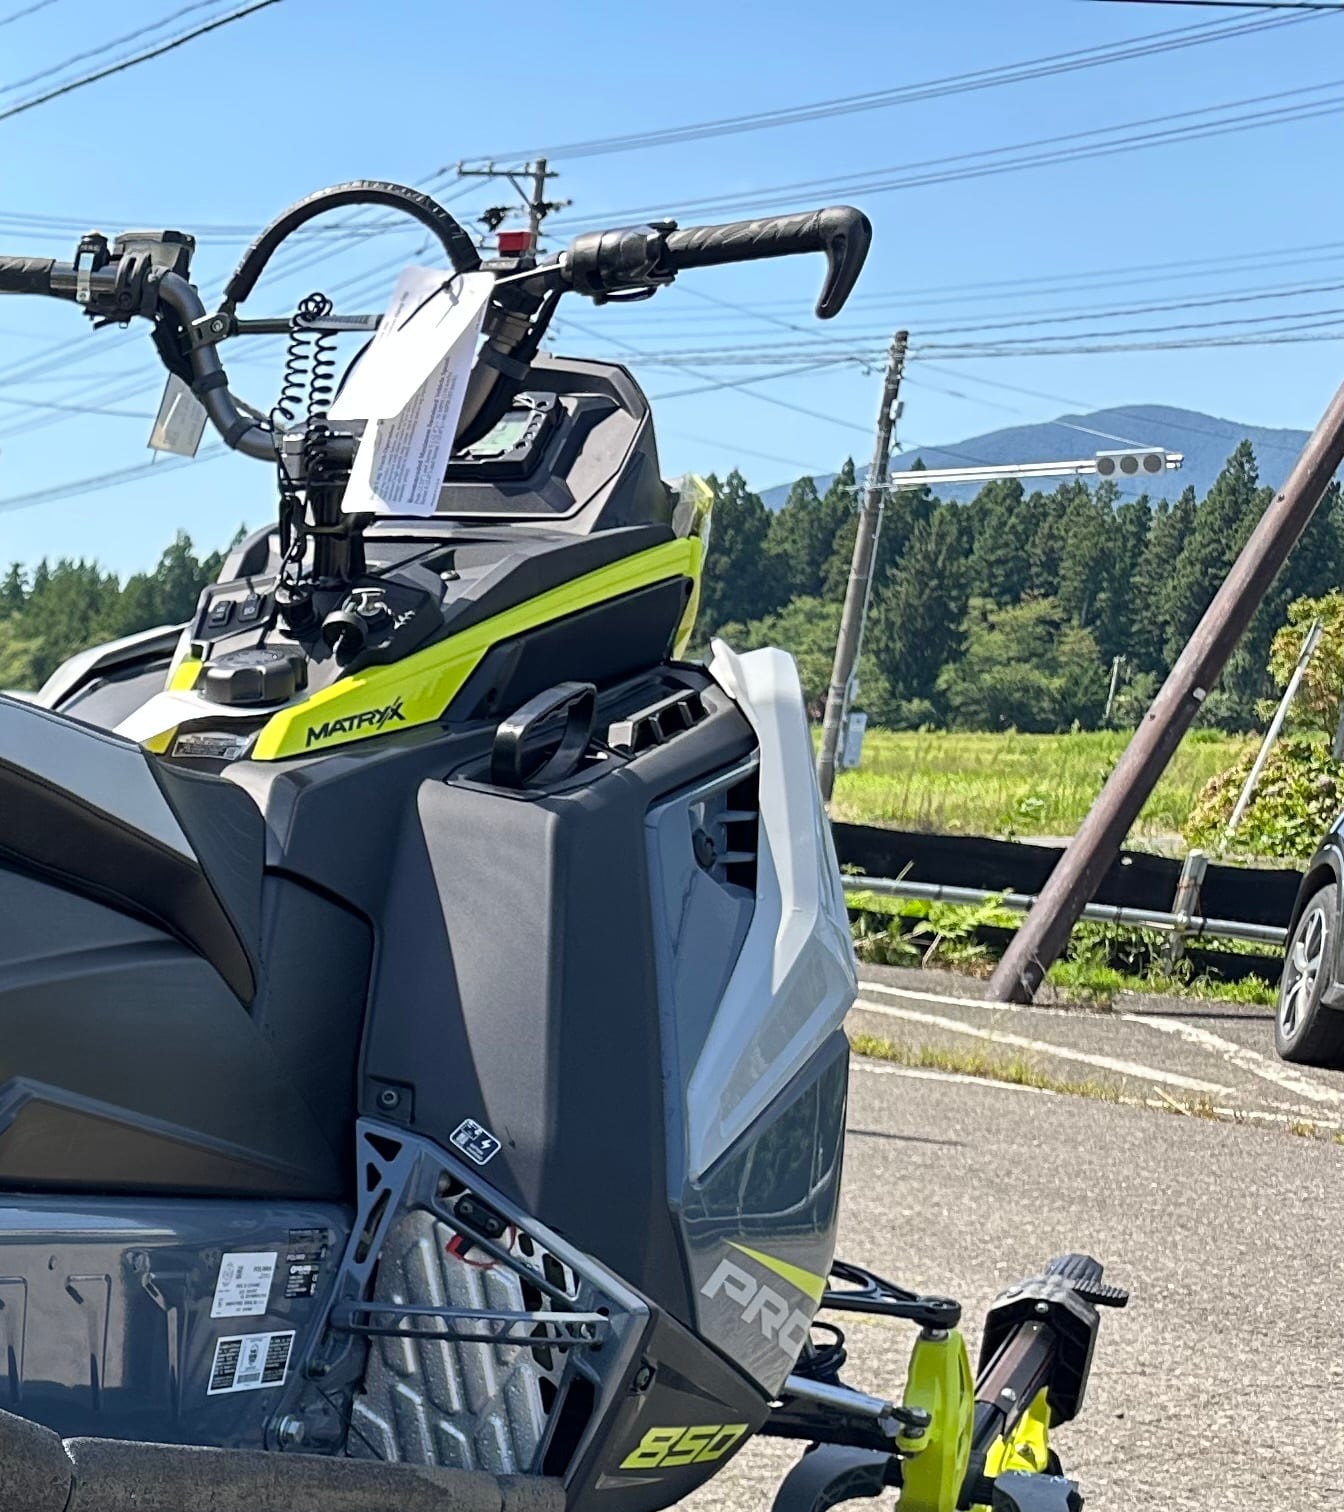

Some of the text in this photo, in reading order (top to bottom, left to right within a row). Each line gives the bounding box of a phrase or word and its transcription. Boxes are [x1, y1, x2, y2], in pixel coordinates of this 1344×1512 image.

[305, 696, 406, 748] MATRYX
[700, 1258, 812, 1361] PRO
[619, 1424, 749, 1469] 850
